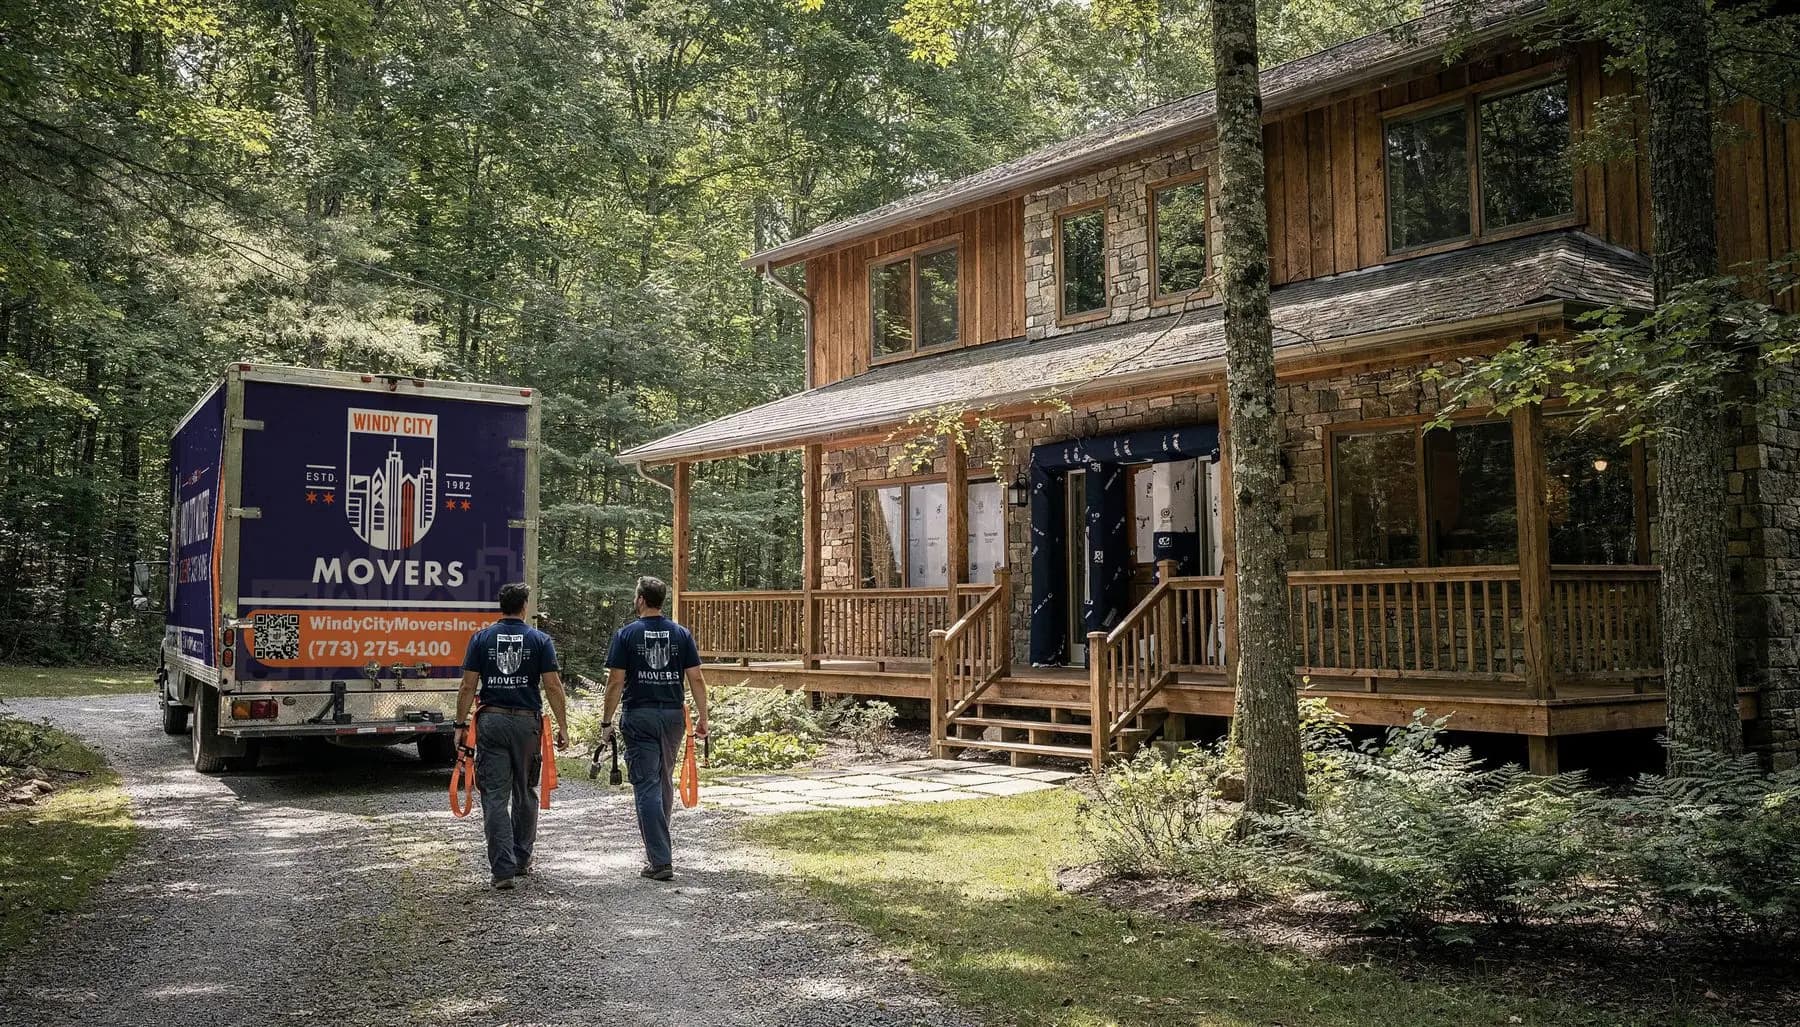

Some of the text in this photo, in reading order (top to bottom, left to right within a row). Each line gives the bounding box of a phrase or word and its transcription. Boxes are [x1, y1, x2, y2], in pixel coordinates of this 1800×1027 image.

[353, 412, 433, 436] WINDY CITY
[306, 471, 338, 482] ESTD.
[446, 480, 471, 490] 1982
[312, 557, 464, 587] MOVERS
[309, 615, 496, 633] WindyCityMoversInc.c
[308, 640, 451, 660] (773) 275-4100
[488, 676, 529, 685] MOVERS
[638, 671, 680, 680] MOVERS
